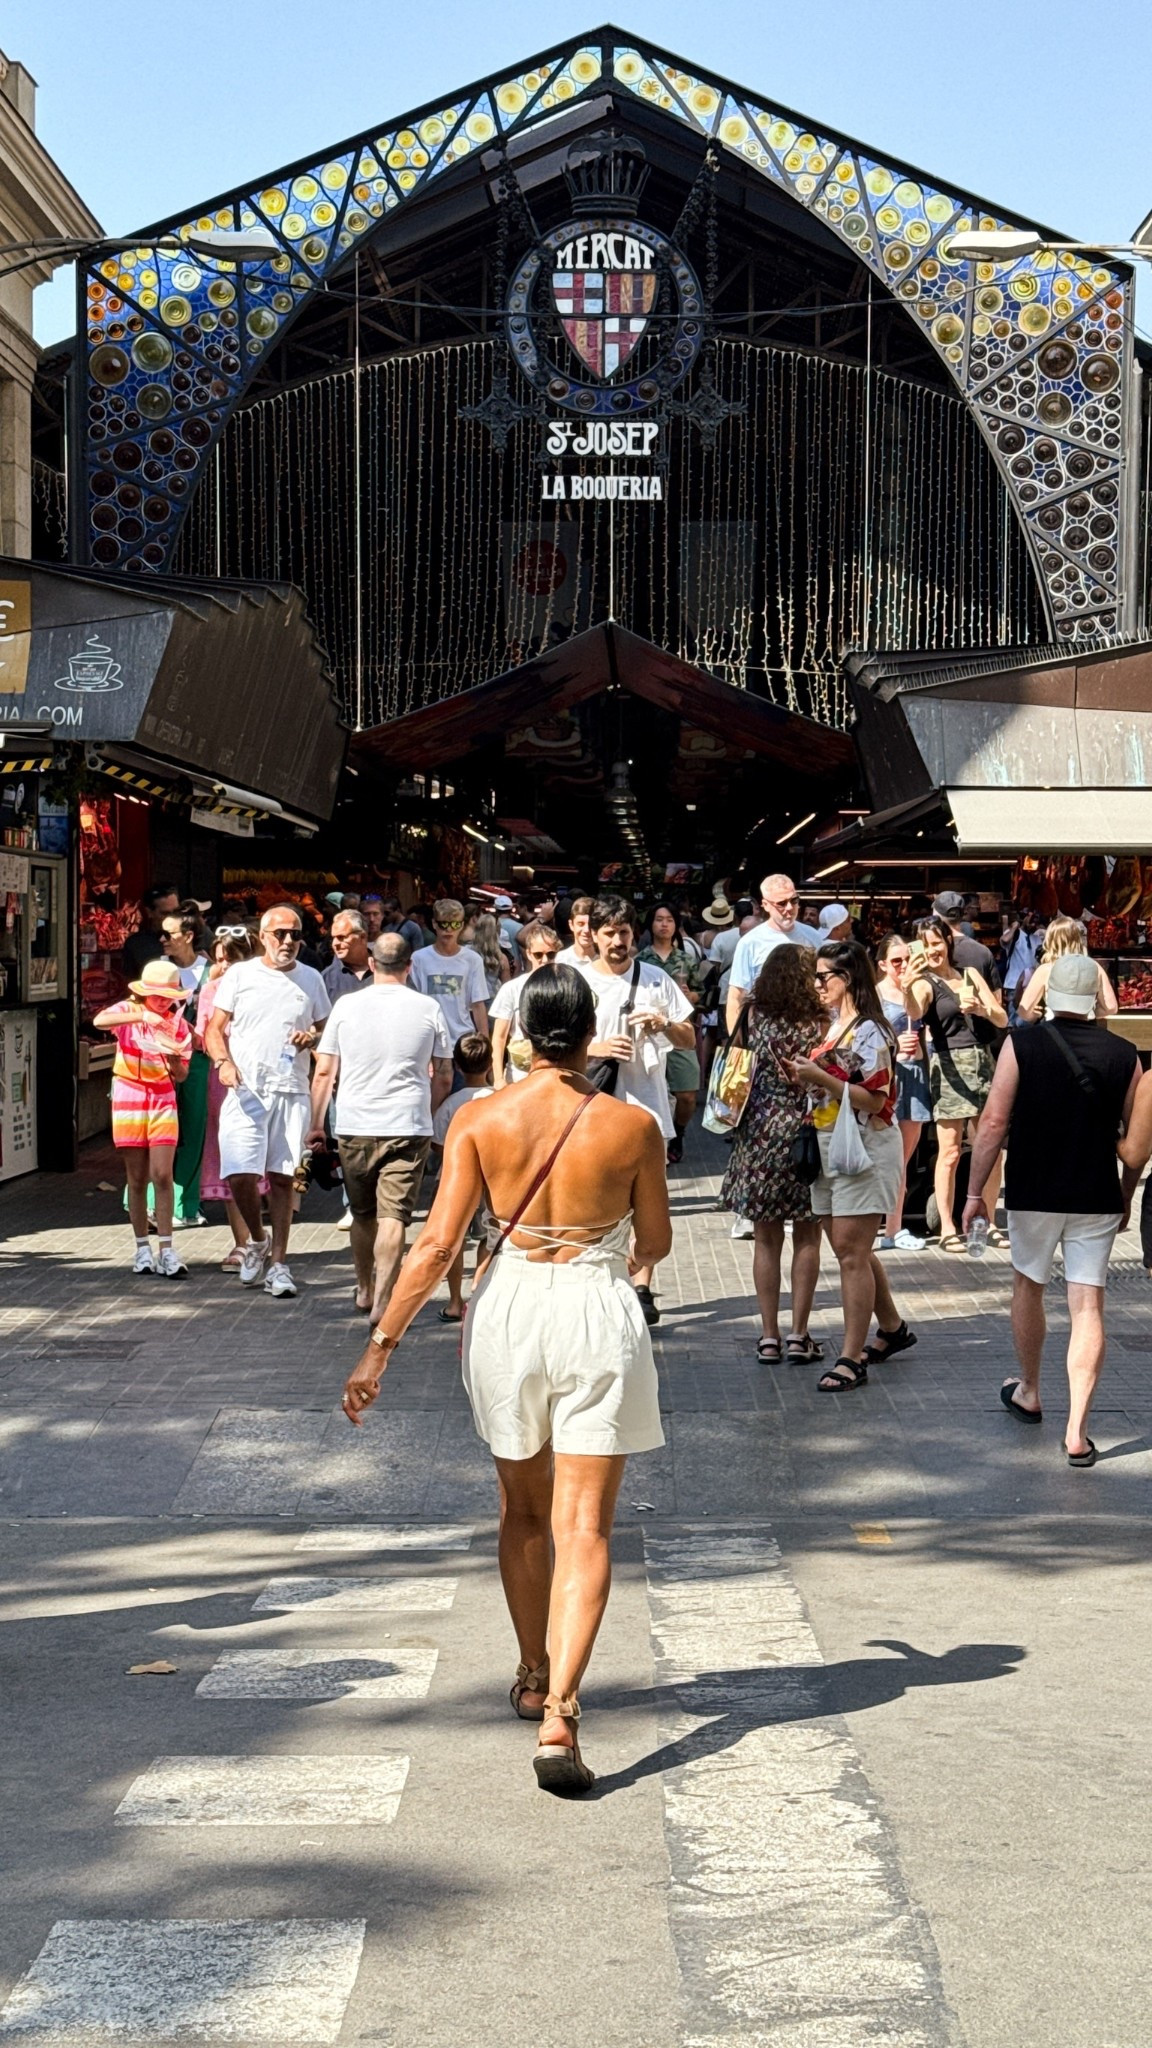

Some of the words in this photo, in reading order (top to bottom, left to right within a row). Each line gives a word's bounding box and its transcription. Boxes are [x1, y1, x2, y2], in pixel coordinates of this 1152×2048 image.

[556, 232, 655, 270] MERCAT
[571, 423, 659, 455] JOSEP
[542, 475, 567, 500] LA
[570, 476, 663, 500] BOQUERIA
